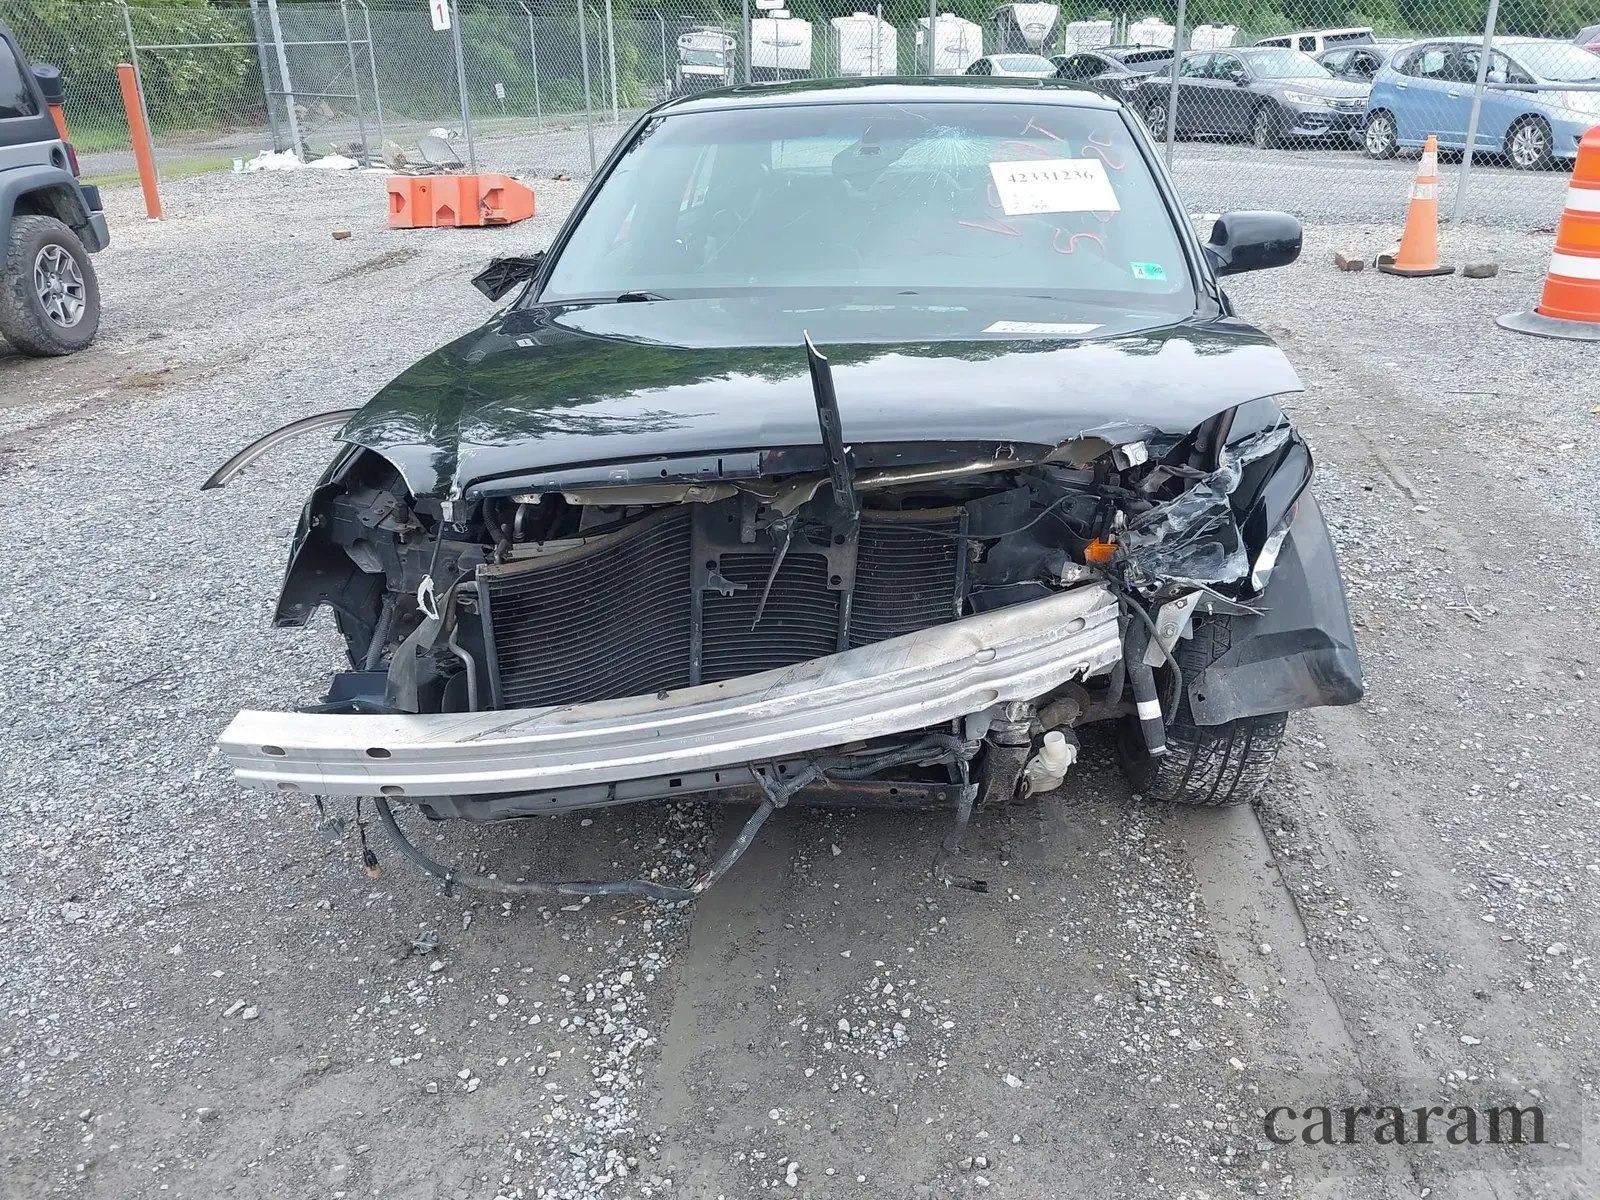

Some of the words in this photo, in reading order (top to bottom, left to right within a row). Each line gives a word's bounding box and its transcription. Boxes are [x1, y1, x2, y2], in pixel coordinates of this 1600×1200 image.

[436, 3, 444, 24] 1
[1007, 170, 1094, 183] 42331236
[1137, 268, 1144, 276] 4
